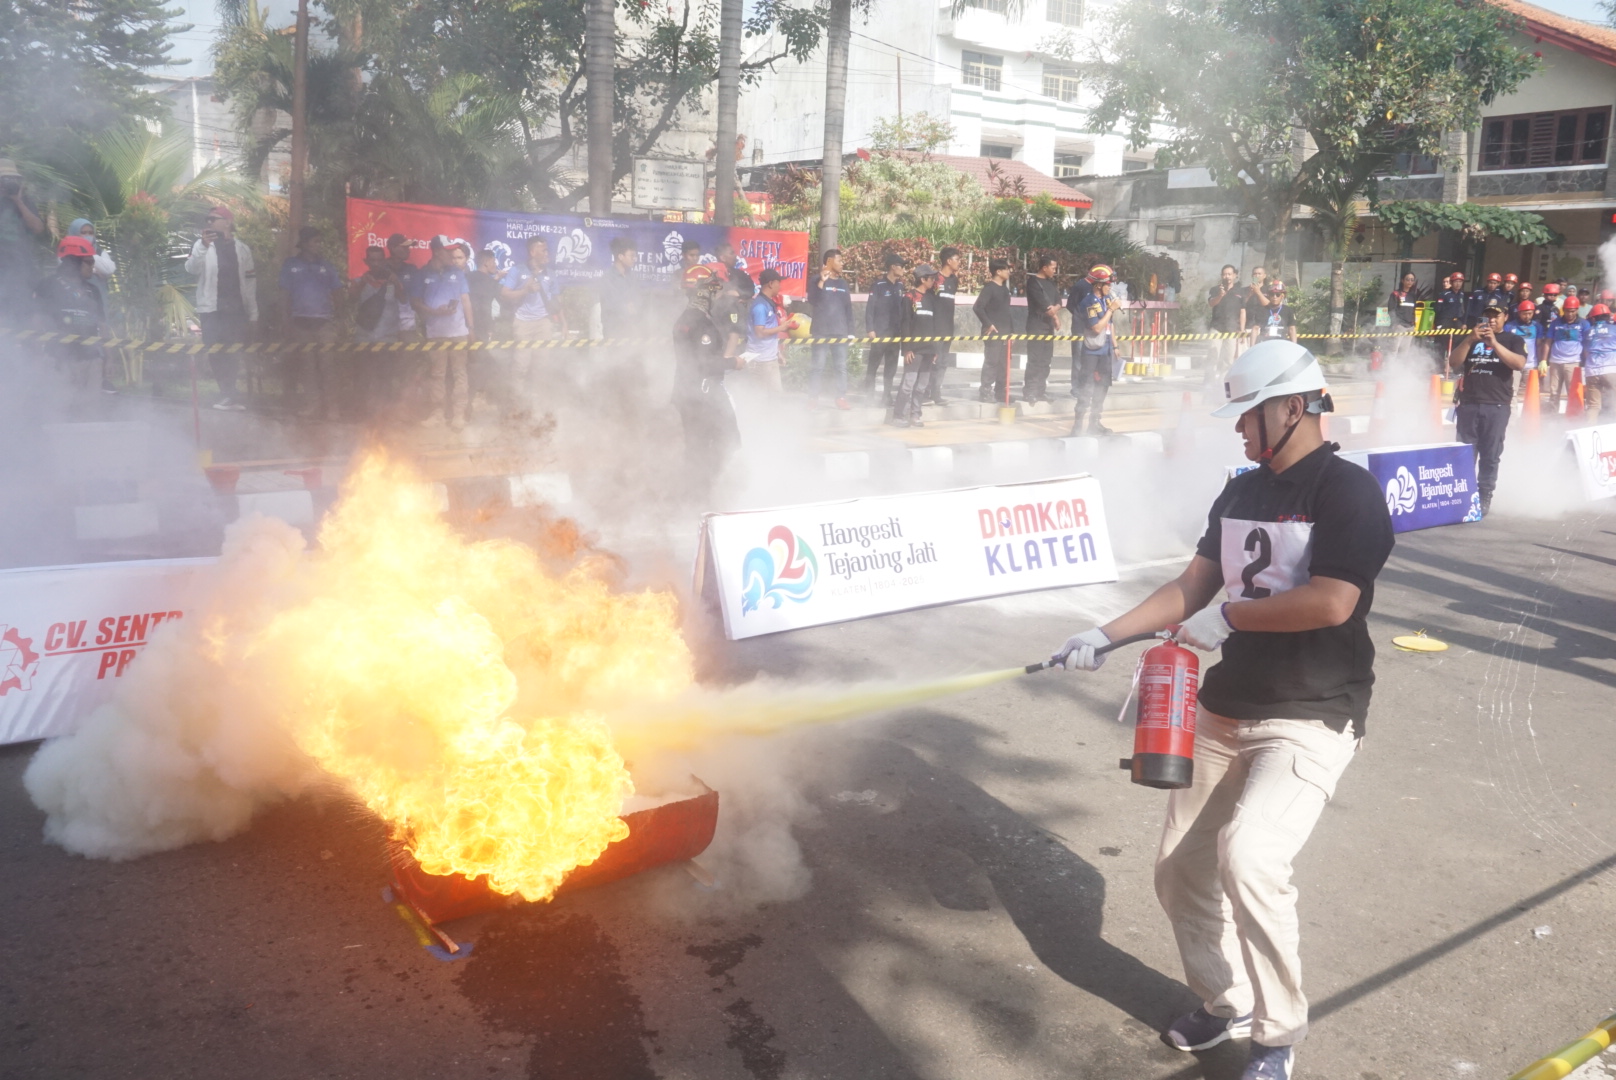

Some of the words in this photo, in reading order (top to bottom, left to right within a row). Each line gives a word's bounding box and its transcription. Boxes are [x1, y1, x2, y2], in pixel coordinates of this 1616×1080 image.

[506, 222, 523, 231] HARI
[524, 224, 540, 232] JADI
[540, 224, 567, 234] KE-221
[740, 238, 783, 260] SAFETY
[1418, 462, 1454, 482] Hangesti
[1420, 481, 1453, 501] Tejaning
[1453, 477, 1468, 493] Jati
[819, 516, 904, 549] Hangesti
[978, 498, 1090, 540] DAMKAR
[823, 546, 904, 581] Tejaning
[906, 541, 938, 567] Jati
[983, 531, 1099, 576] KLATEN
[1241, 527, 1271, 599] 2
[830, 584, 867, 597] KLATEN
[44, 619, 87, 651] CV.
